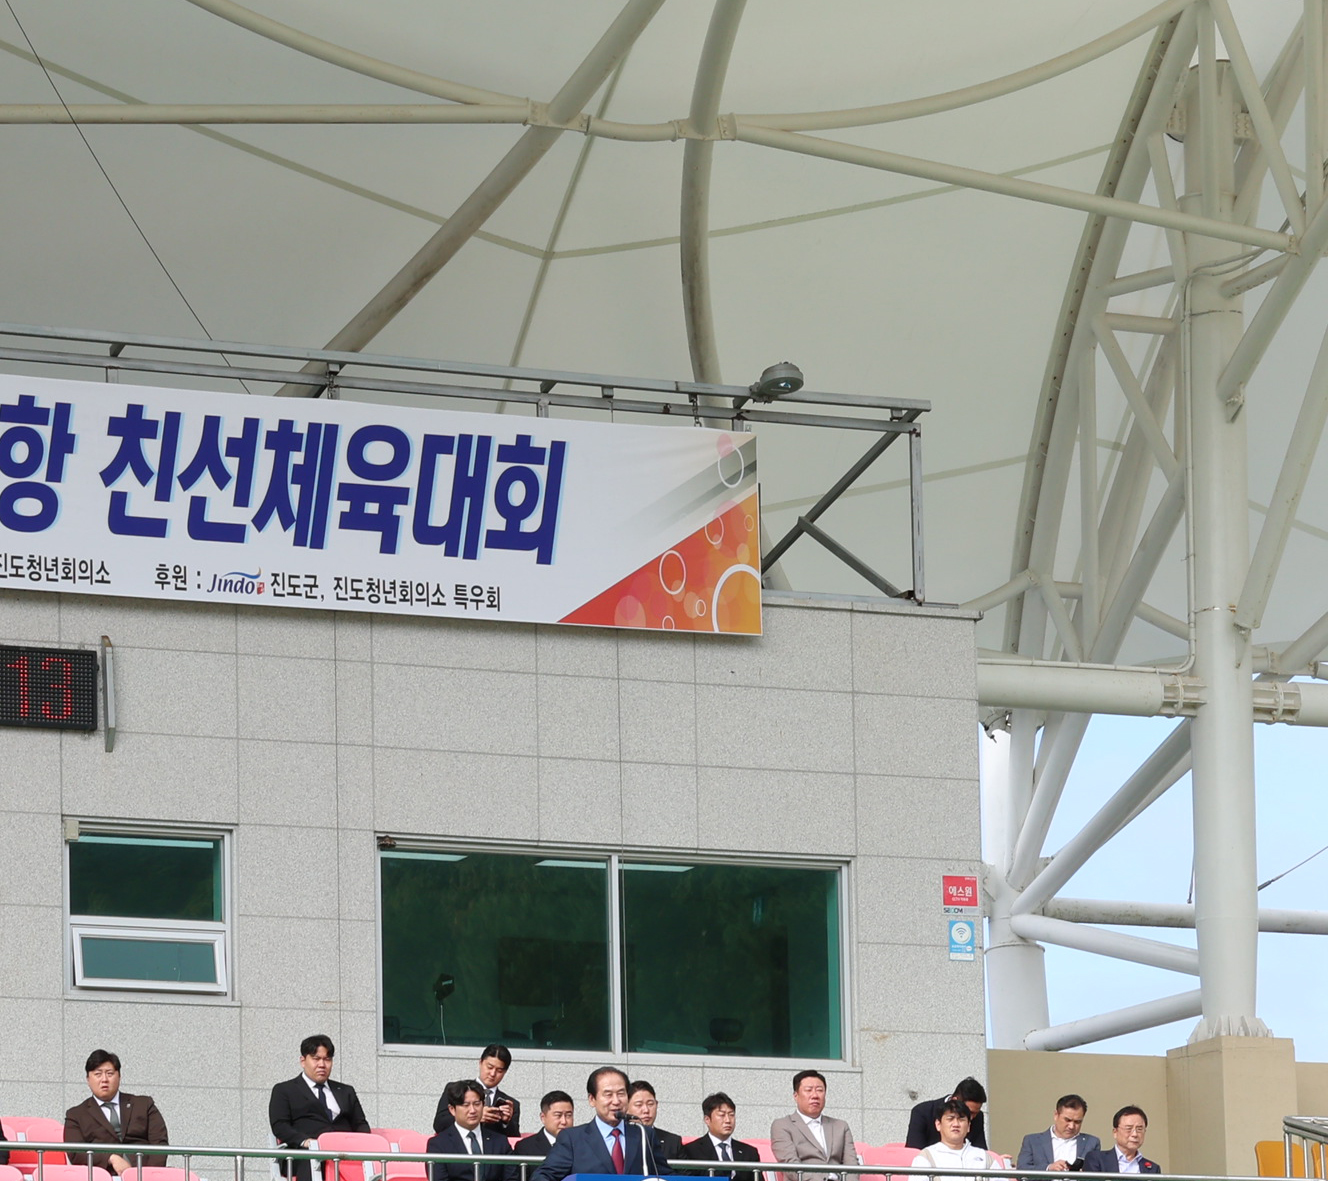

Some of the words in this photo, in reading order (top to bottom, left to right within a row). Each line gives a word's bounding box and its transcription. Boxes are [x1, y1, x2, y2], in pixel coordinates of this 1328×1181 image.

[98, 403, 567, 566] 친선체육대회
[155, 563, 187, 591] 후원
[207, 573, 255, 596] Jindo
[270, 572, 325, 602] 진도군,
[333, 576, 446, 608] 진도청년회의소
[453, 584, 501, 612] 특우회
[7, 657, 73, 719] 13
[948, 886, 972, 897] 에스원
